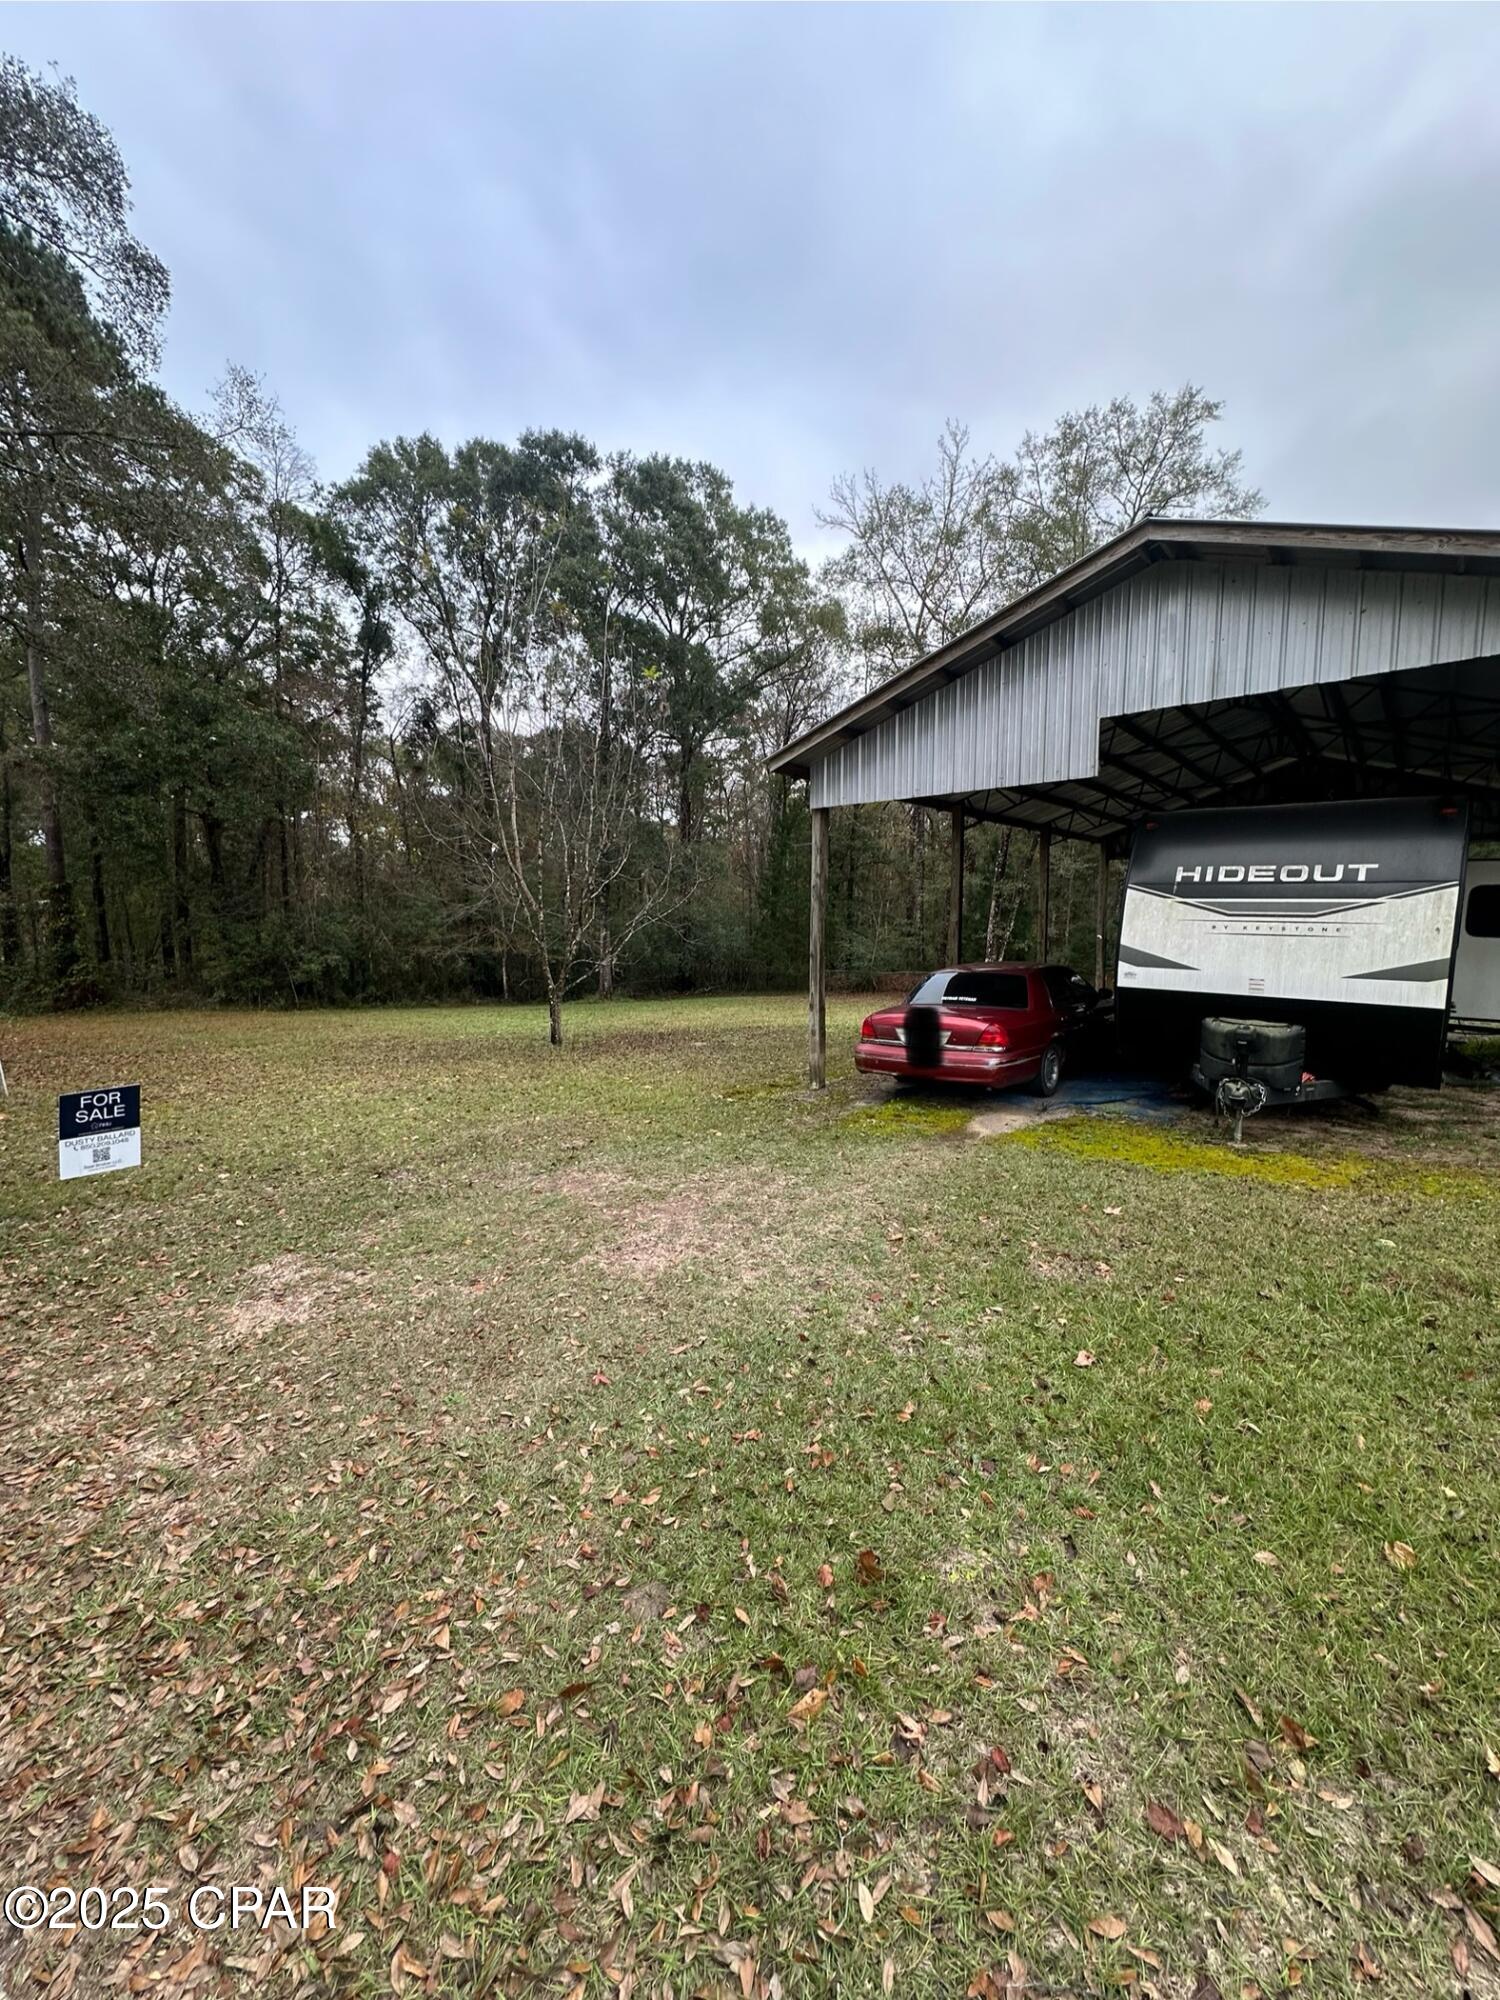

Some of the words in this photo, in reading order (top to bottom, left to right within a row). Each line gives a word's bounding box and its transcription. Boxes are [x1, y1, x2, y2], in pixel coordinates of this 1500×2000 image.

[1175, 863, 1380, 883] HIDEOUT
[1242, 925, 1342, 933] KEYSTONE
[80, 1091, 121, 1109] FOR
[75, 1104, 126, 1124] SALE
[64, 1136, 96, 1148] DUSTY
[97, 1130, 136, 1143] BALLARD
